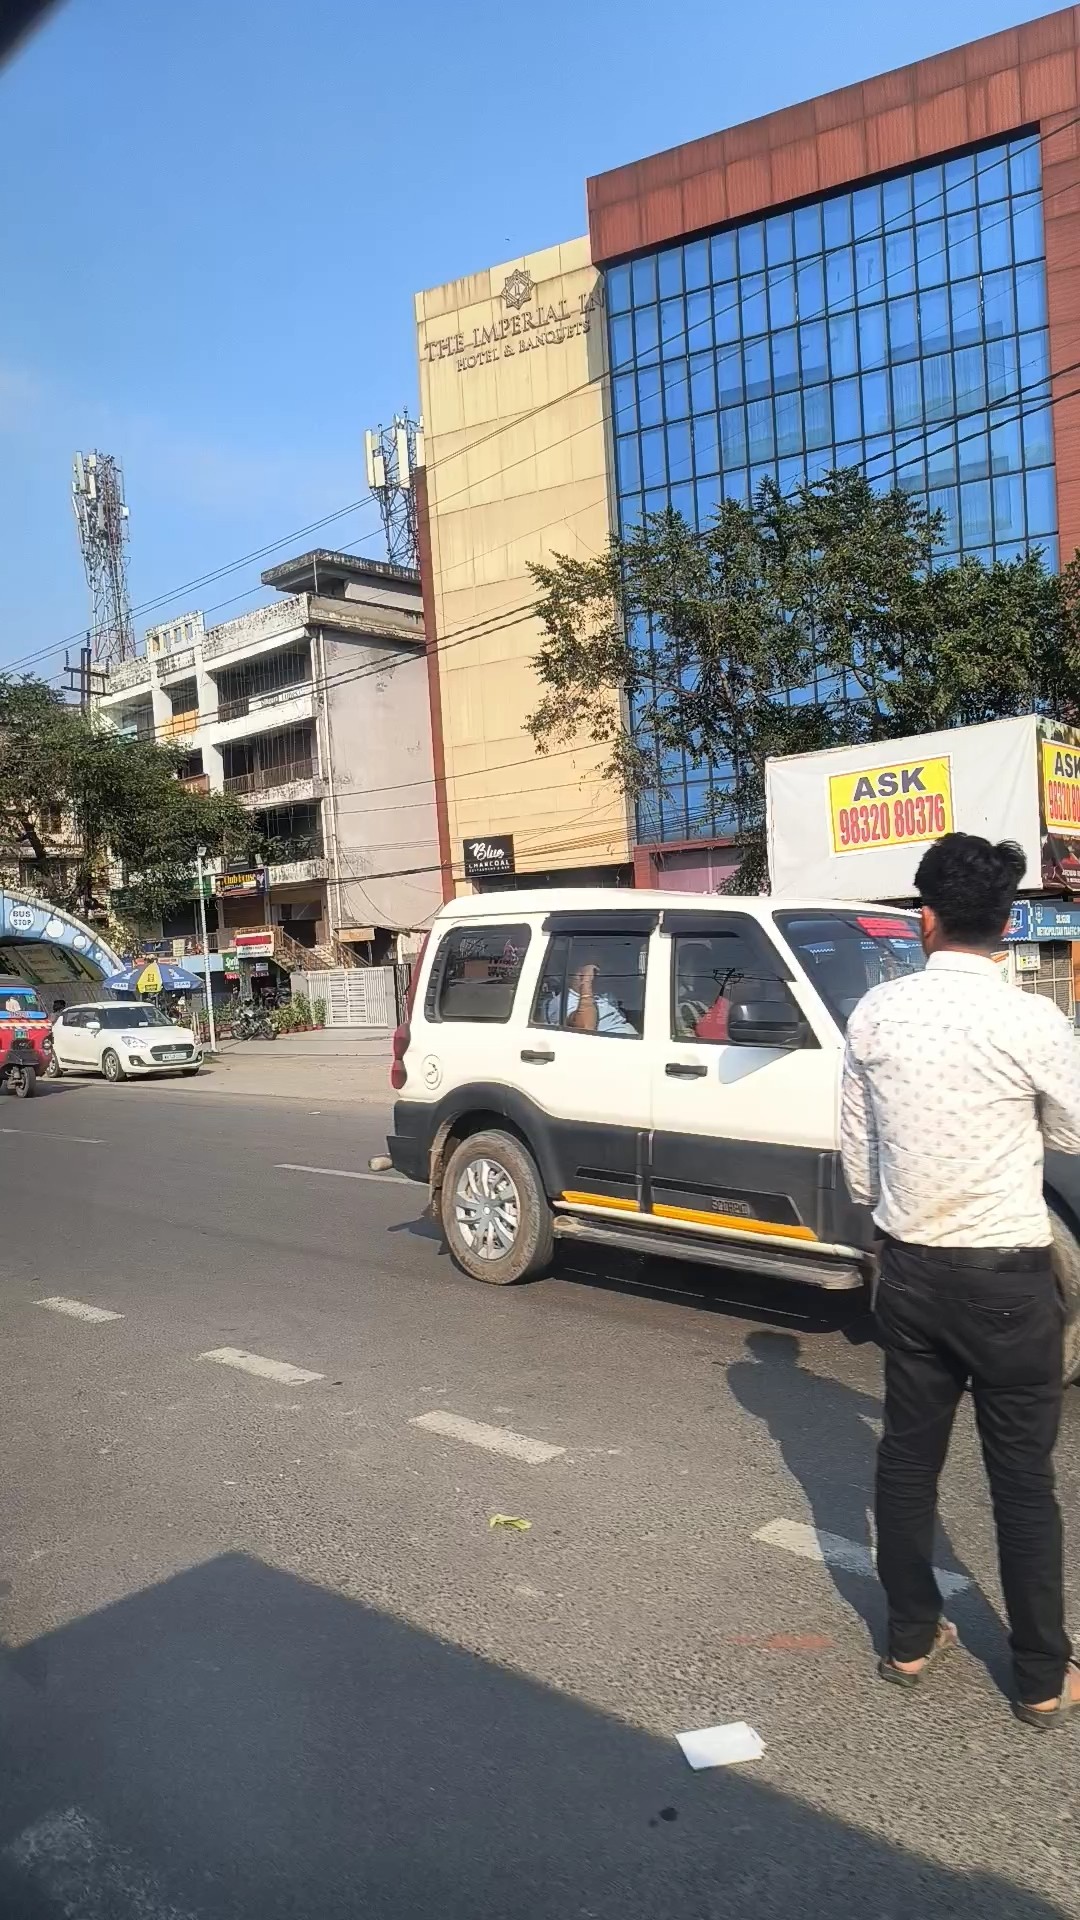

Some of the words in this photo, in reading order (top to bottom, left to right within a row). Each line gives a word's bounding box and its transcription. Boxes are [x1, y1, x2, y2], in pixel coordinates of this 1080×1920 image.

[424, 332, 464, 362] THE
[472, 299, 571, 349] IMPERIAL
[457, 348, 500, 373] HOTEL
[503, 344, 515, 358] &
[518, 319, 591, 354] BANQUETS
[853, 766, 926, 802] ASK
[839, 802, 890, 845] 98320
[893, 793, 945, 838] 80376
[469, 842, 505, 861] Blue
[12, 910, 31, 918] BUS
